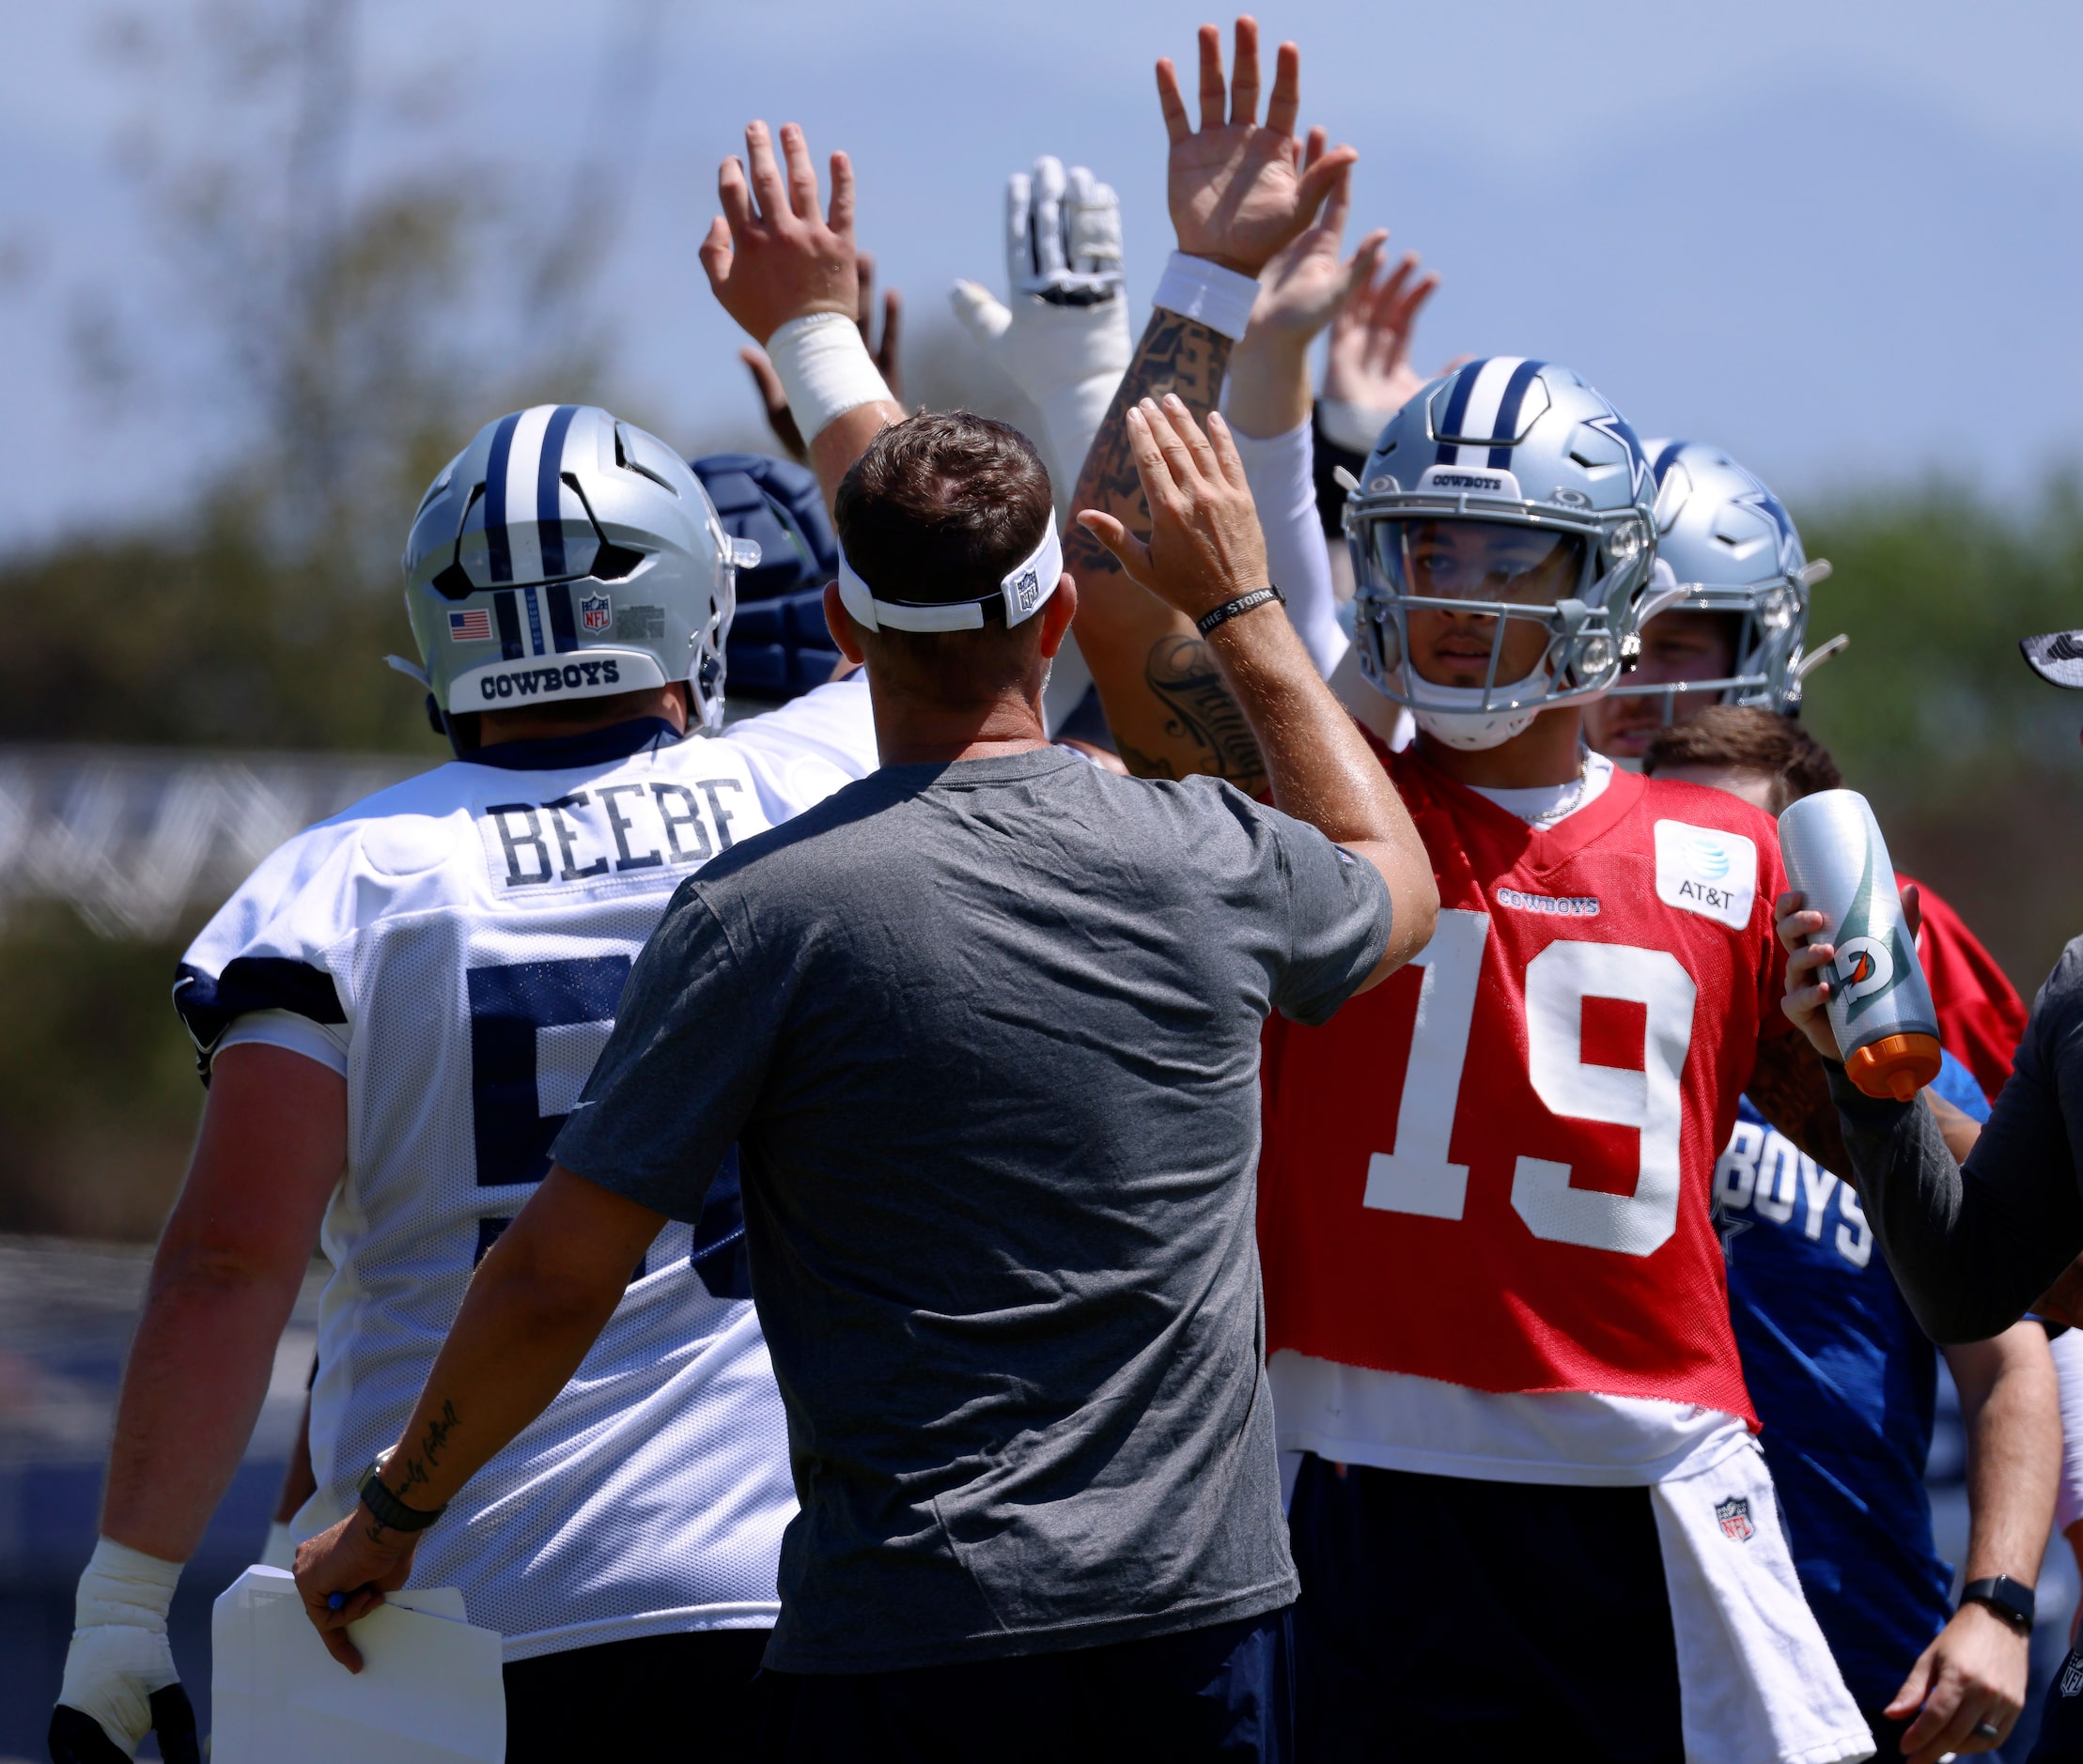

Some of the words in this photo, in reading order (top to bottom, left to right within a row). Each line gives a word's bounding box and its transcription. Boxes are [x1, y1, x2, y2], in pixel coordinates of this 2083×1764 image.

[1433, 474, 1502, 489] COWBOYS
[585, 611, 609, 628] NFL
[1201, 611, 1222, 629] THE
[1226, 589, 1274, 614] STORM
[480, 659, 620, 701] COWBOYS
[1497, 887, 1600, 916] COWBOYS
[1679, 879, 1735, 910] AT&T
[1362, 907, 1698, 1258] 19
[1720, 1515, 1751, 1540] NFL
